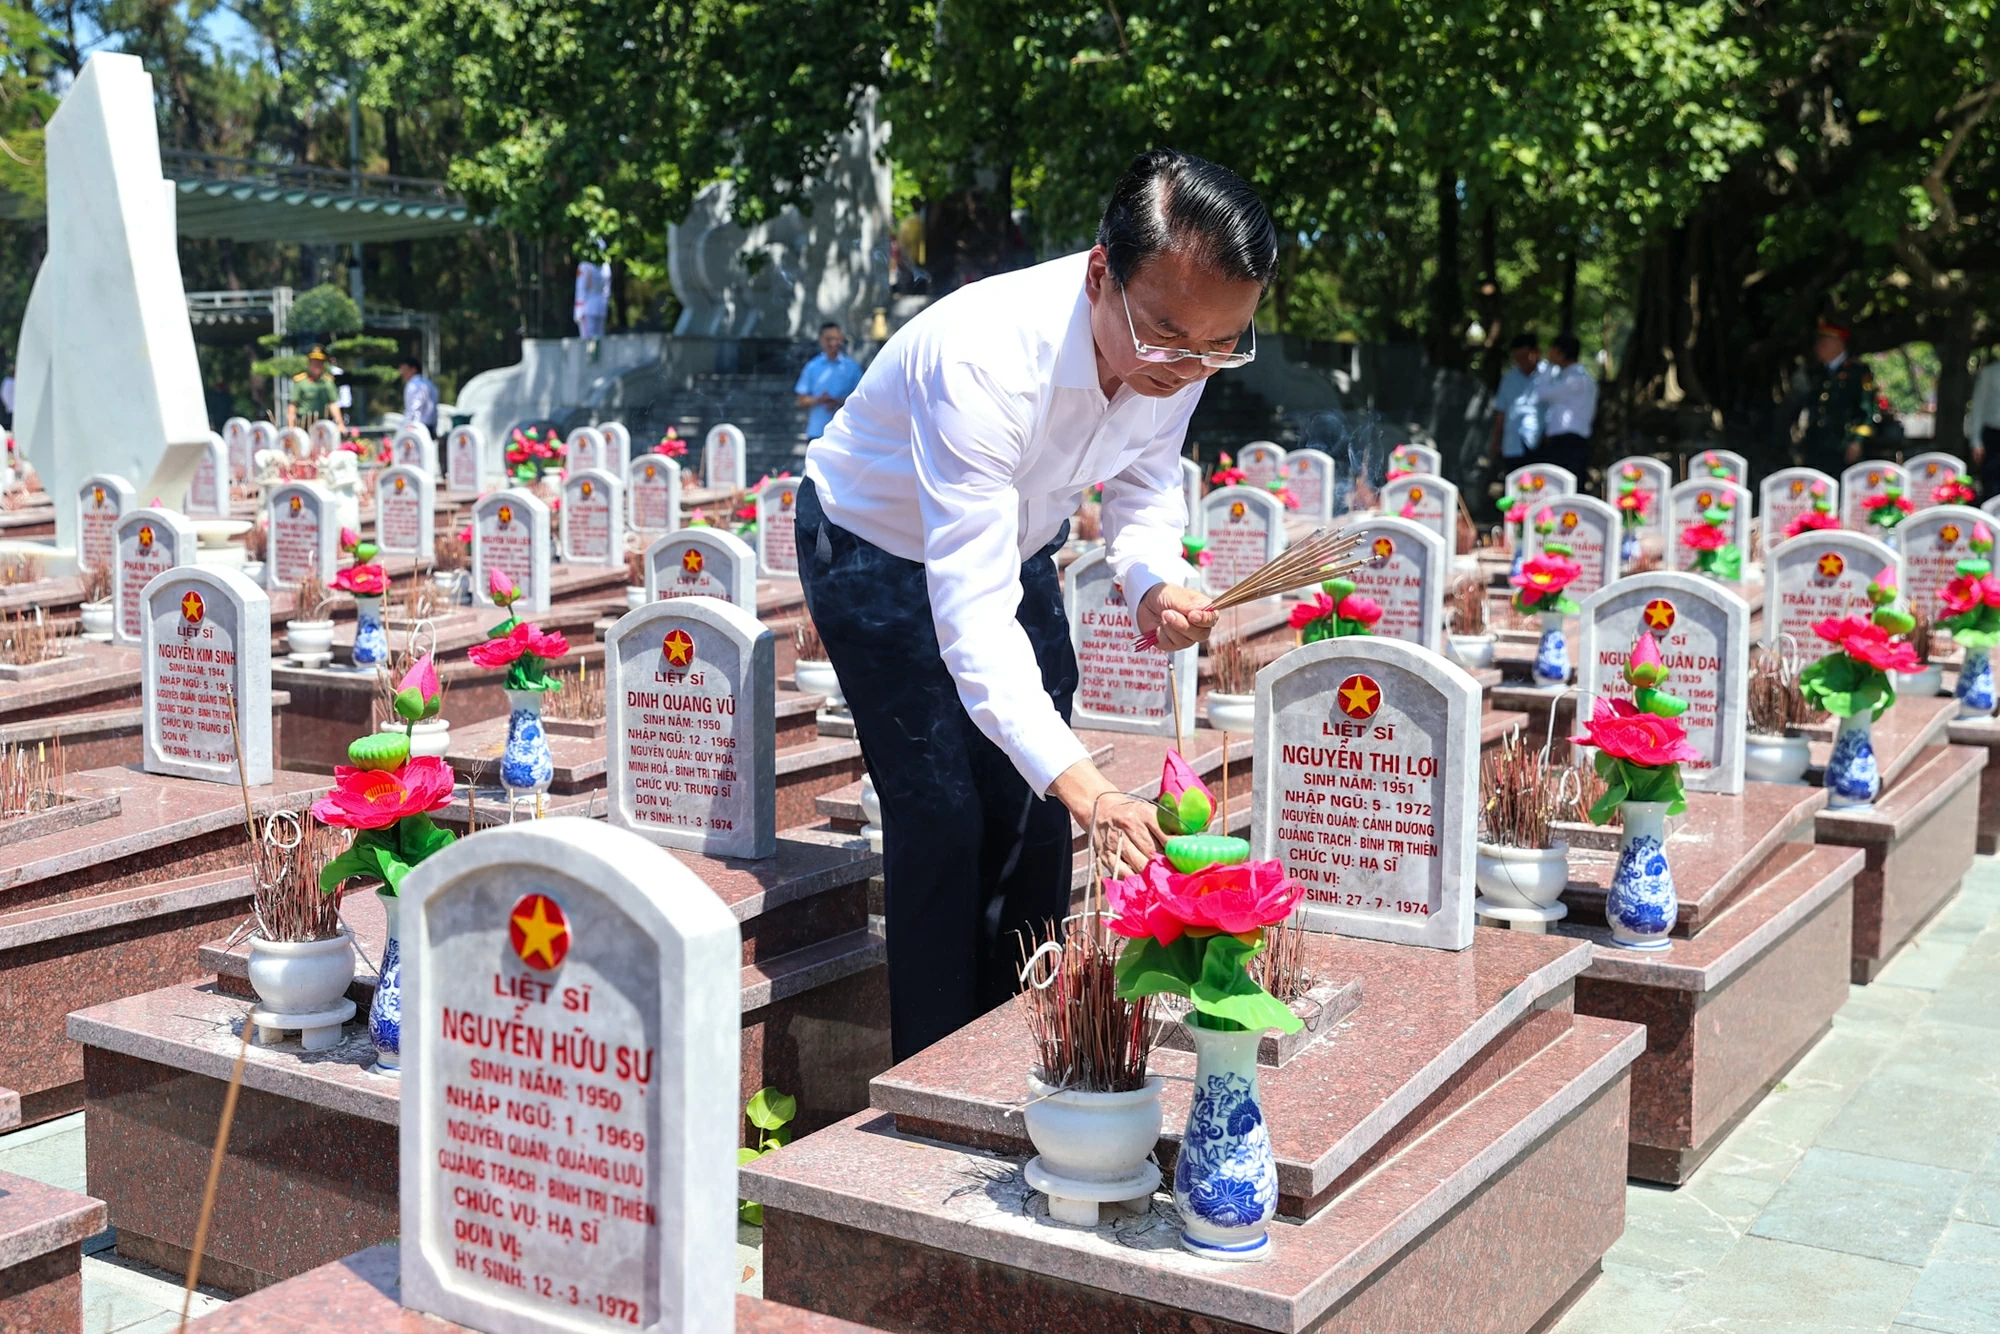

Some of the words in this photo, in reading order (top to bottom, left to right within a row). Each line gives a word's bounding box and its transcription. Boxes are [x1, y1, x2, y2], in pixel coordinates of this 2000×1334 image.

[655, 670, 685, 686] LIỆT
[690, 672, 704, 685] SĨ
[1698, 656, 1721, 675] ĐẠI
[628, 692, 658, 708] ĐINH
[663, 694, 712, 713] QUANG
[716, 695, 735, 715] VŨ
[644, 714, 665, 725] SINH
[668, 714, 693, 728] NĂM:
[698, 720, 720, 730] 1950
[1323, 720, 1366, 738] LIỆT
[1374, 724, 1396, 740] SĨ
[628, 727, 656, 743] NHẬP
[660, 731, 685, 743] NGŨ:
[690, 735, 700, 745] 12
[711, 737, 736, 748] 1965
[631, 744, 664, 757] NGUYÊN
[666, 747, 692, 760] QUÁN:
[695, 752, 712, 762] QUY
[1283, 738, 1362, 770] NGUYỄN
[1370, 753, 1399, 780] THỊ
[1407, 756, 1437, 782] LỢI
[629, 761, 648, 772] MINH
[676, 764, 694, 777] BÌNH
[697, 768, 709, 781] TRỊ
[712, 768, 736, 781] THIÊN
[1304, 773, 1335, 786] SINH
[1340, 774, 1376, 790] NĂM:
[1383, 781, 1413, 794] 1951
[636, 777, 662, 790] CHỨC
[665, 781, 681, 794] VỤ:
[684, 783, 718, 796] TRUNG
[722, 784, 731, 797] SĨ
[636, 794, 656, 805] ĐƠN
[660, 796, 671, 810] VỊ:
[1286, 789, 1325, 810] NHẬP
[1331, 794, 1367, 809] NGŨ:
[1373, 800, 1380, 811] 5
[1397, 802, 1430, 816] 1972
[636, 810, 647, 820] HY
[650, 812, 674, 823] SINH:
[678, 815, 687, 825] 11
[696, 817, 702, 826] 3
[711, 819, 732, 830] 1974
[1282, 807, 1323, 824] NGUYÊN
[1327, 812, 1359, 828] QUÁN:
[1363, 814, 1392, 832] CẢNH
[1396, 821, 1434, 836] DƯƠNG
[1278, 824, 1314, 842] QUẢNG
[1318, 832, 1350, 849] TRẠCH
[1360, 835, 1384, 850] BÌNH
[1388, 840, 1403, 857] TRỊ
[1407, 840, 1437, 856] THIÊN
[1290, 847, 1326, 863] CHỨC
[1332, 853, 1354, 870] VỤ:
[1360, 856, 1378, 873] HẠ
[1384, 857, 1398, 871] SĨ
[1290, 867, 1318, 881] ĐƠN
[1323, 872, 1340, 888] VỊ:
[1307, 889, 1341, 904] SINH:
[1346, 894, 1362, 906] 27
[1375, 898, 1382, 908] 7
[1397, 901, 1428, 914] 1974
[494, 973, 552, 1006] LIỆT
[562, 984, 592, 1013] SĨ
[443, 1004, 542, 1060] NGUYỄN
[552, 1027, 606, 1073] HỮU
[616, 1046, 654, 1094] SỰ
[471, 1059, 512, 1086] SINH
[520, 1068, 568, 1100] NĂM:
[578, 1085, 621, 1111] 1950
[447, 1086, 500, 1119] NHẬP
[508, 1100, 556, 1130] NGŨ:
[567, 1116, 572, 1135] 1
[598, 1124, 644, 1152] 1969
[448, 1118, 503, 1150] NGUYÊN
[508, 1134, 552, 1164] QUÁN:
[557, 1144, 608, 1179] QUẢNG
[613, 1162, 643, 1187] LƯU
[439, 1146, 485, 1179] QUẢNG
[490, 1162, 535, 1193] TRẠCH
[549, 1178, 581, 1206] BÌNH
[584, 1188, 607, 1219] TRỊ
[612, 1195, 655, 1226] THIÊN
[454, 1186, 503, 1217] CHỨC
[510, 1202, 540, 1232] VỤ:
[548, 1212, 574, 1244] HẠ
[582, 1219, 600, 1244] SĨ
[455, 1219, 492, 1247] ĐƠN
[500, 1232, 522, 1262] VỊ:
[456, 1249, 476, 1272] HY
[483, 1258, 526, 1289] SINH:
[534, 1276, 552, 1297] 12
[570, 1286, 578, 1304] 3
[598, 1295, 638, 1323] 1972
